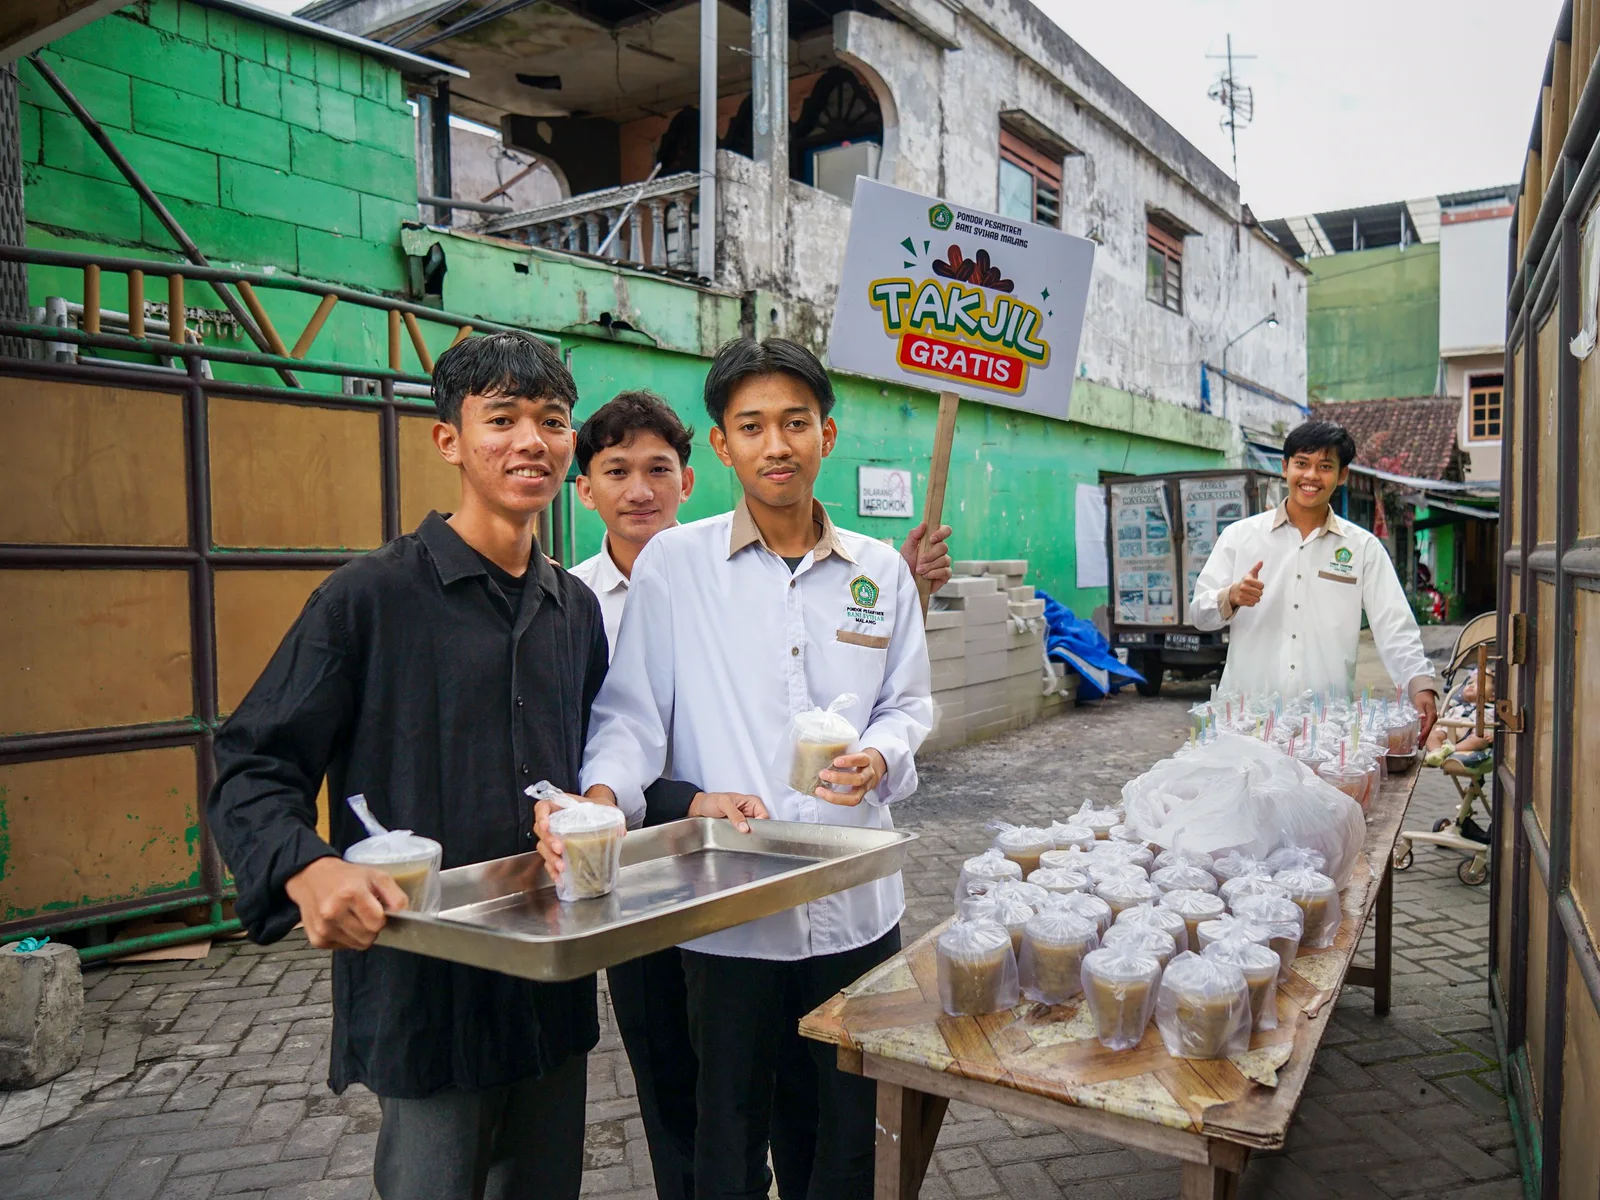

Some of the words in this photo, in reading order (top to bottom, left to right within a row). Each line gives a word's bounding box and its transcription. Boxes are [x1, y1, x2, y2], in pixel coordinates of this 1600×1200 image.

[956, 212, 984, 226] PONDOK
[984, 219, 1022, 236] PESANTREN
[955, 222, 972, 234] BANI
[973, 226, 999, 241] SYIHAB
[1000, 234, 1029, 248] MALANG
[873, 282, 1045, 360] TAKJIL
[910, 340, 1011, 382] GRATIS
[1200, 481, 1227, 490] JUAL
[863, 488, 893, 498] DILARANG
[1187, 491, 1242, 501] ASSESORIS
[863, 499, 907, 512] MEROKOK
[1123, 495, 1160, 505] MAINA
[855, 617, 877, 625] MALANG
